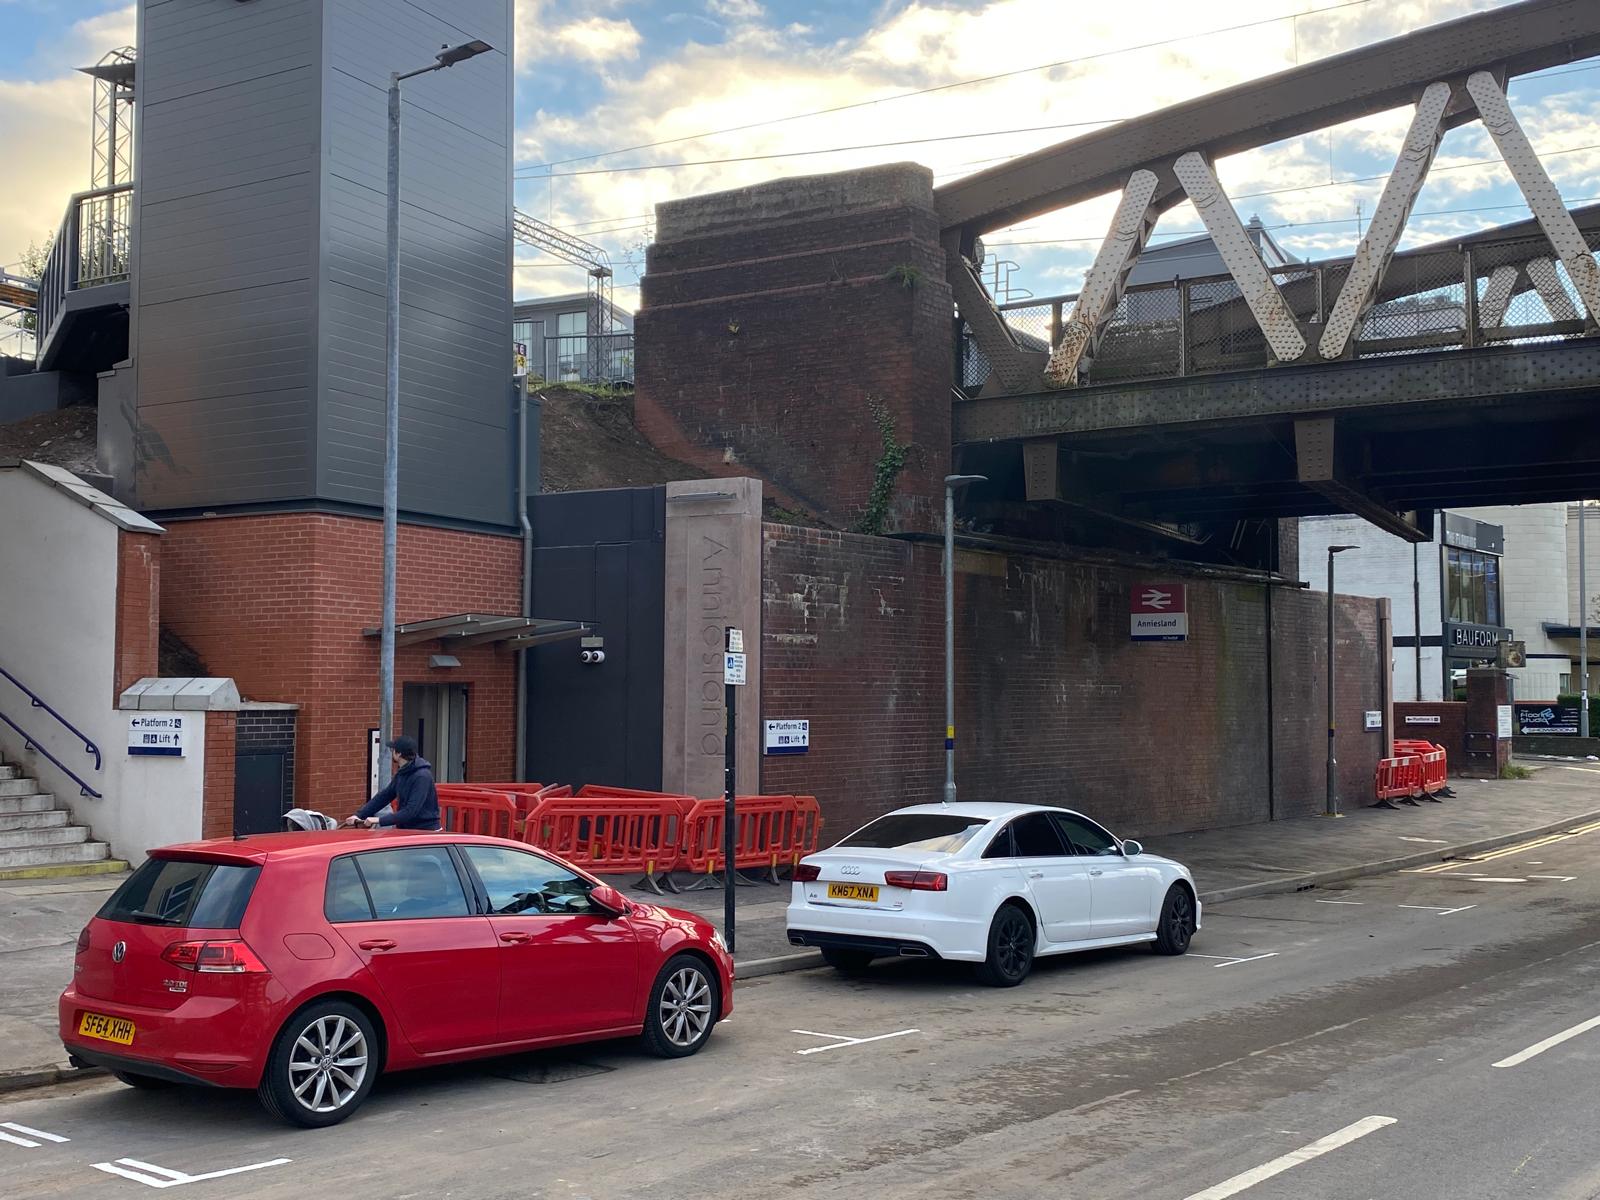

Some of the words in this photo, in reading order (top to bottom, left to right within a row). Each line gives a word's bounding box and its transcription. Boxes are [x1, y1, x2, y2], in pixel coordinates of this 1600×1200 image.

[1137, 619, 1177, 627] Anniesland
[1456, 628, 1498, 647] BAUFORM
[701, 535, 729, 757] Anniesland
[141, 718, 168, 727] Platform
[169, 719, 174, 727] 2
[776, 722, 797, 730] Platform
[798, 722, 802, 730] 2
[159, 733, 171, 743] Lift
[791, 735, 800, 743] Lift
[831, 885, 855, 898] KM67
[857, 886, 875, 898] XNA
[84, 1014, 110, 1036] SF64
[110, 1019, 133, 1041] XHH
